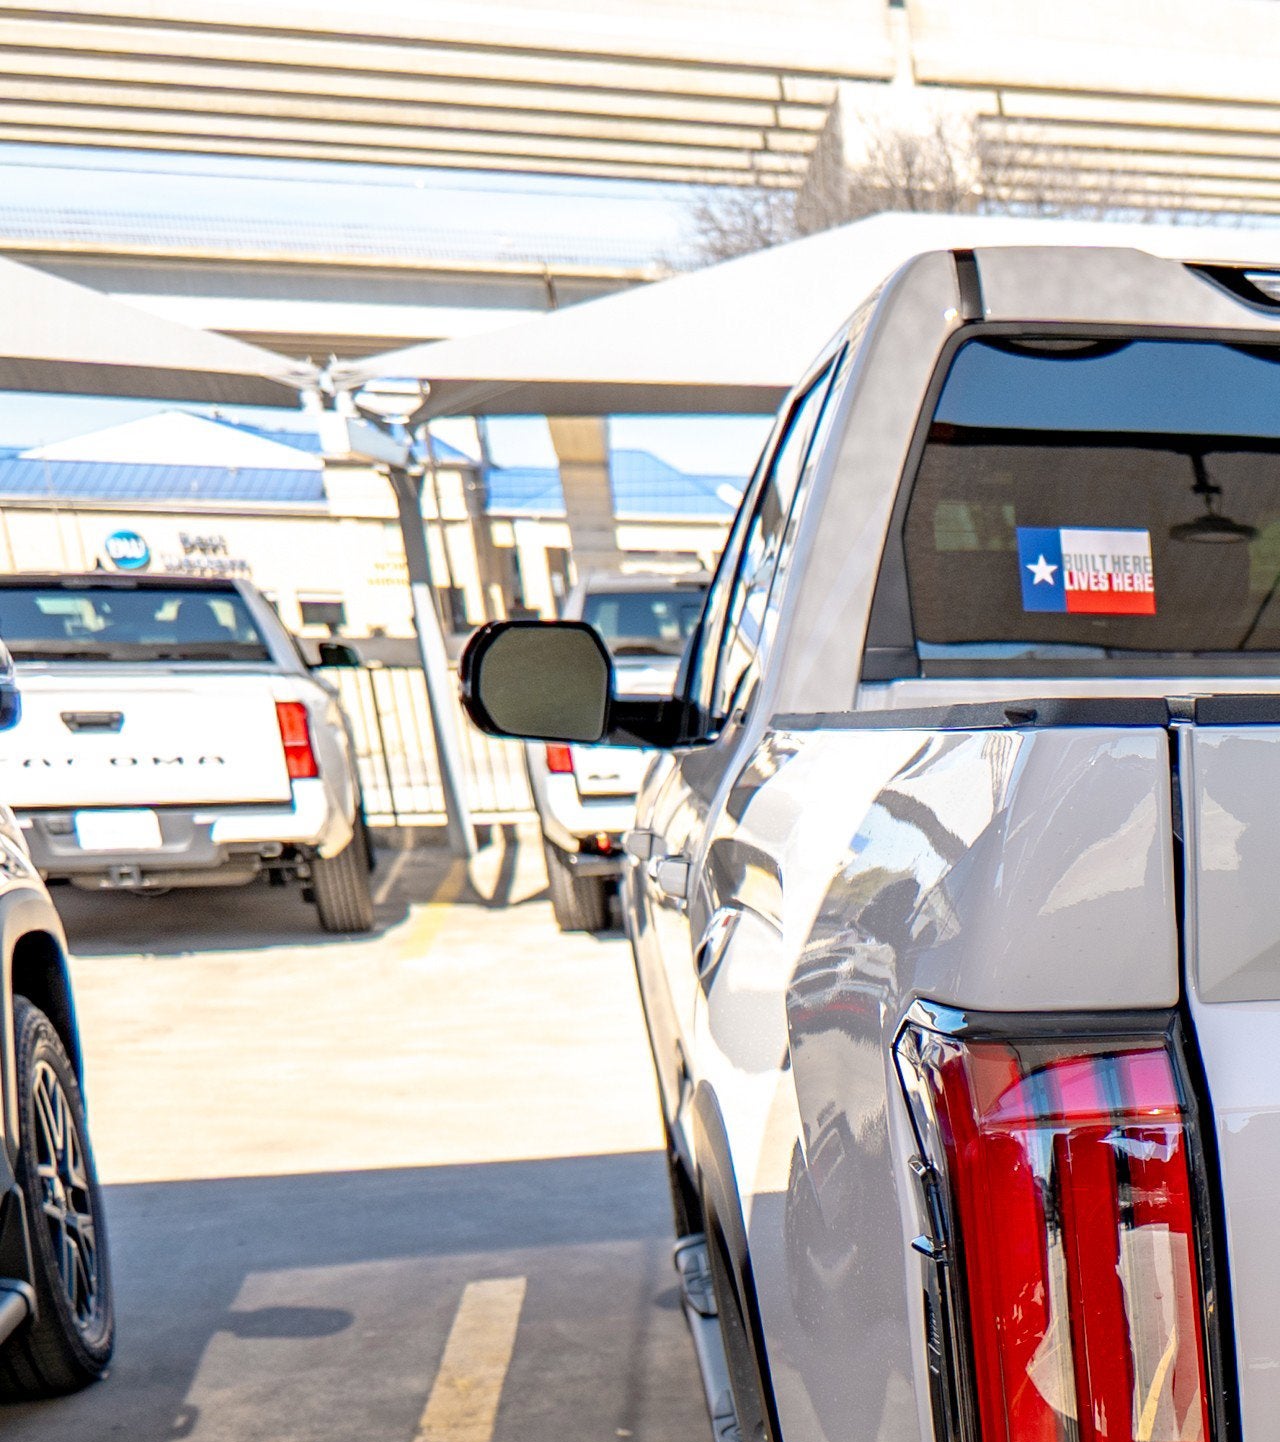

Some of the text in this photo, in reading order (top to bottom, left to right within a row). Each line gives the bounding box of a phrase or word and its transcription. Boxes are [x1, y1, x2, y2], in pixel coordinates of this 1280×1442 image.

[1063, 554, 1152, 573] BUILT HERE
[1065, 572, 1154, 592] LIVES HERE
